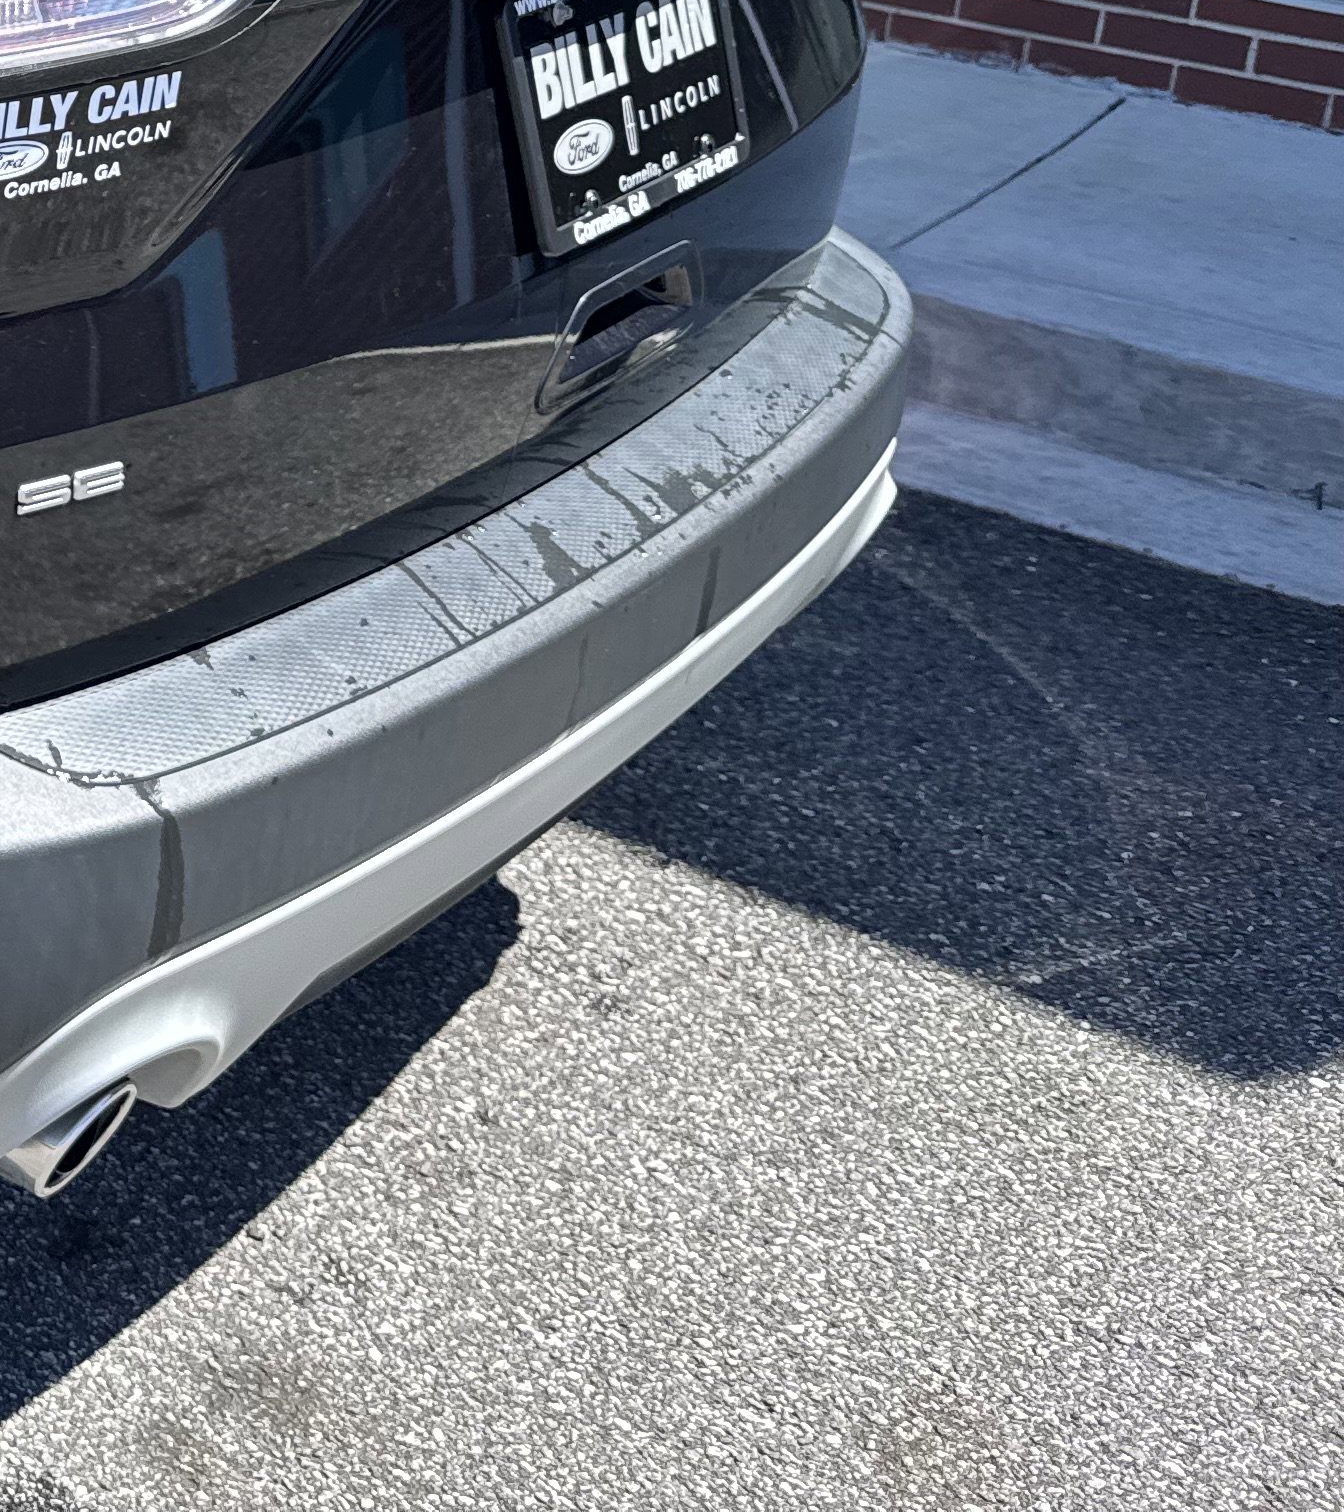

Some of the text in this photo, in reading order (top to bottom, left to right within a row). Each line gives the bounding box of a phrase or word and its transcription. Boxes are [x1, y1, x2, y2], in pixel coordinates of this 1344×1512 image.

[530, 12, 631, 120] BILLY
[87, 71, 183, 125] CAIN
[638, 74, 721, 131] LINCOLN
[75, 120, 172, 157] LINCOLN
[661, 150, 679, 172] GA
[93, 161, 122, 182] GA
[627, 190, 652, 218] GA
[16, 460, 126, 516] SE
